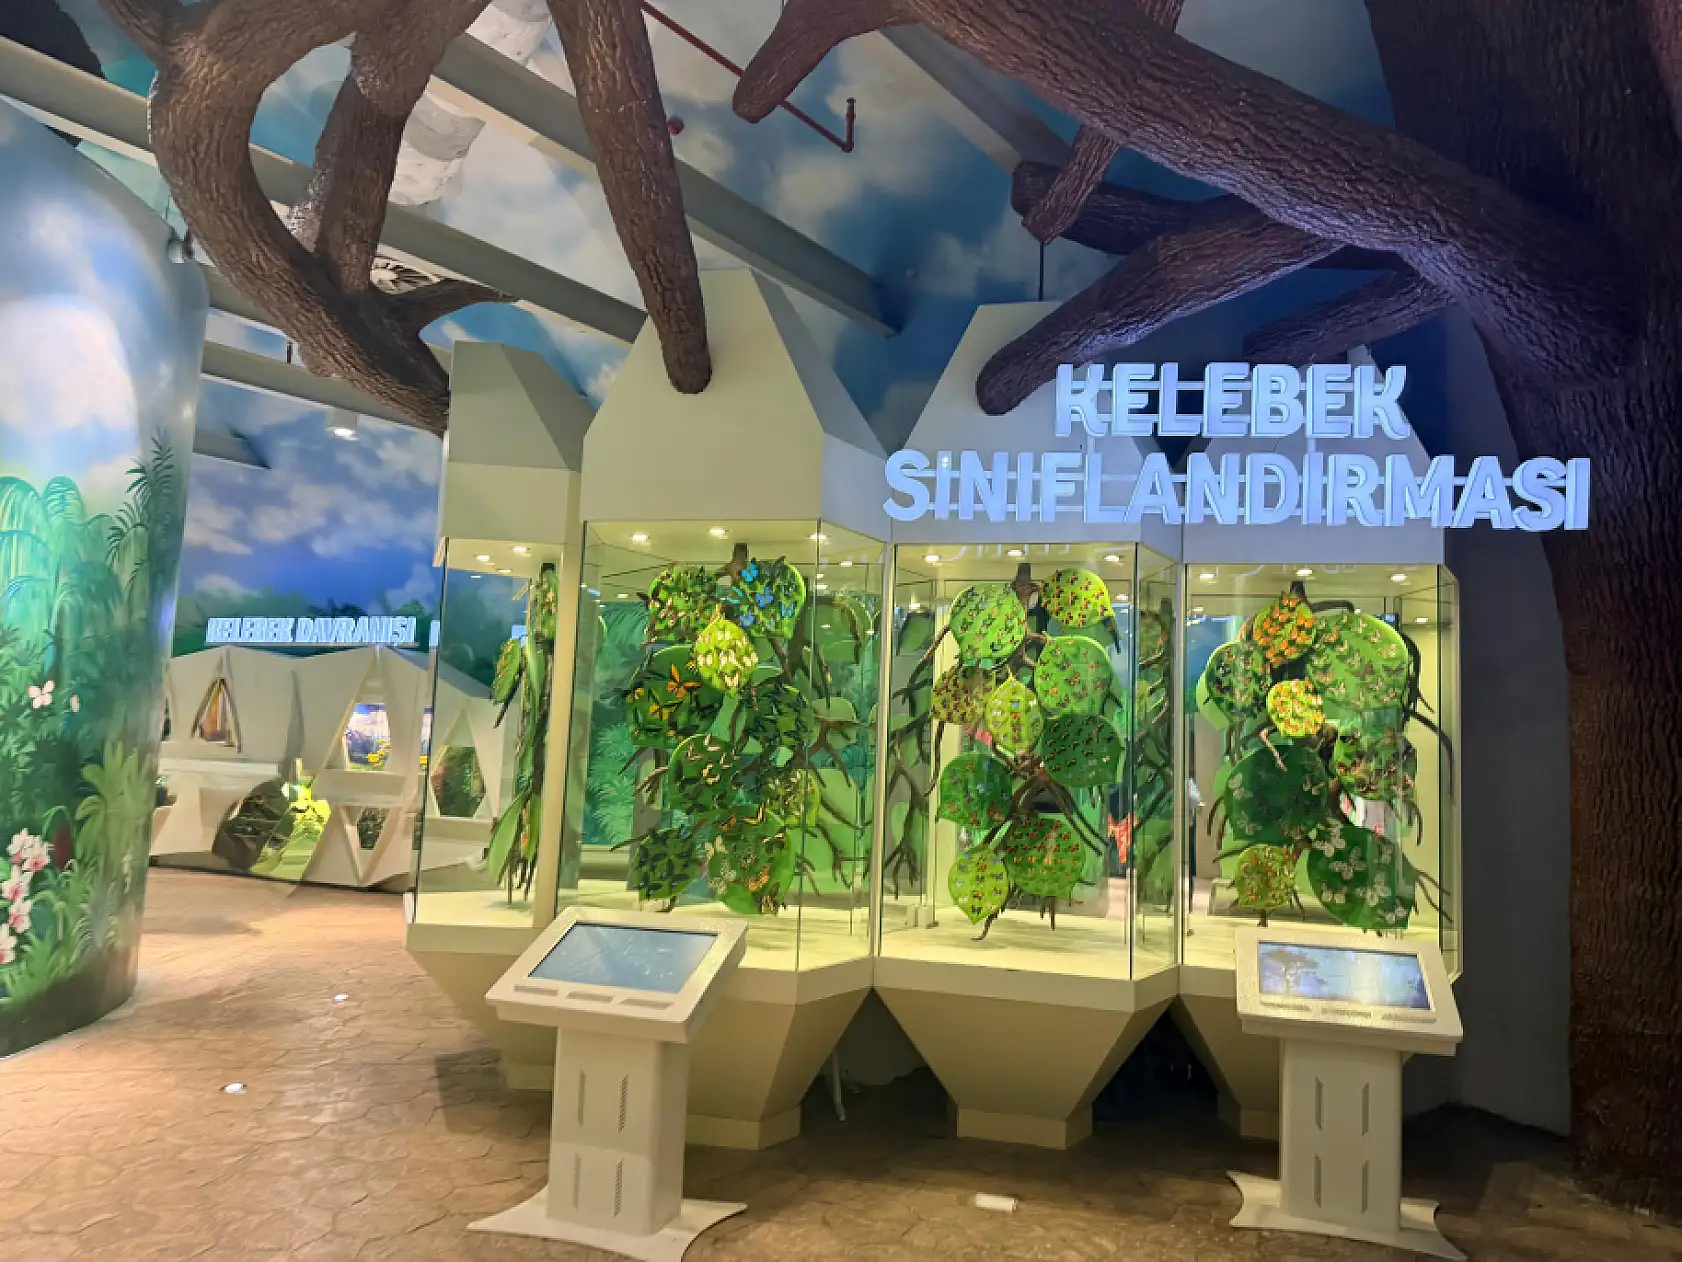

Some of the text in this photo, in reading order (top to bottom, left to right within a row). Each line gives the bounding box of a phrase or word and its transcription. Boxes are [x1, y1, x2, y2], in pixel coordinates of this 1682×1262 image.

[1055, 361, 1411, 441] KELEBEK
[883, 448, 1591, 531] SINIFLANDIRMASI
[206, 617, 295, 643] KELEBEK
